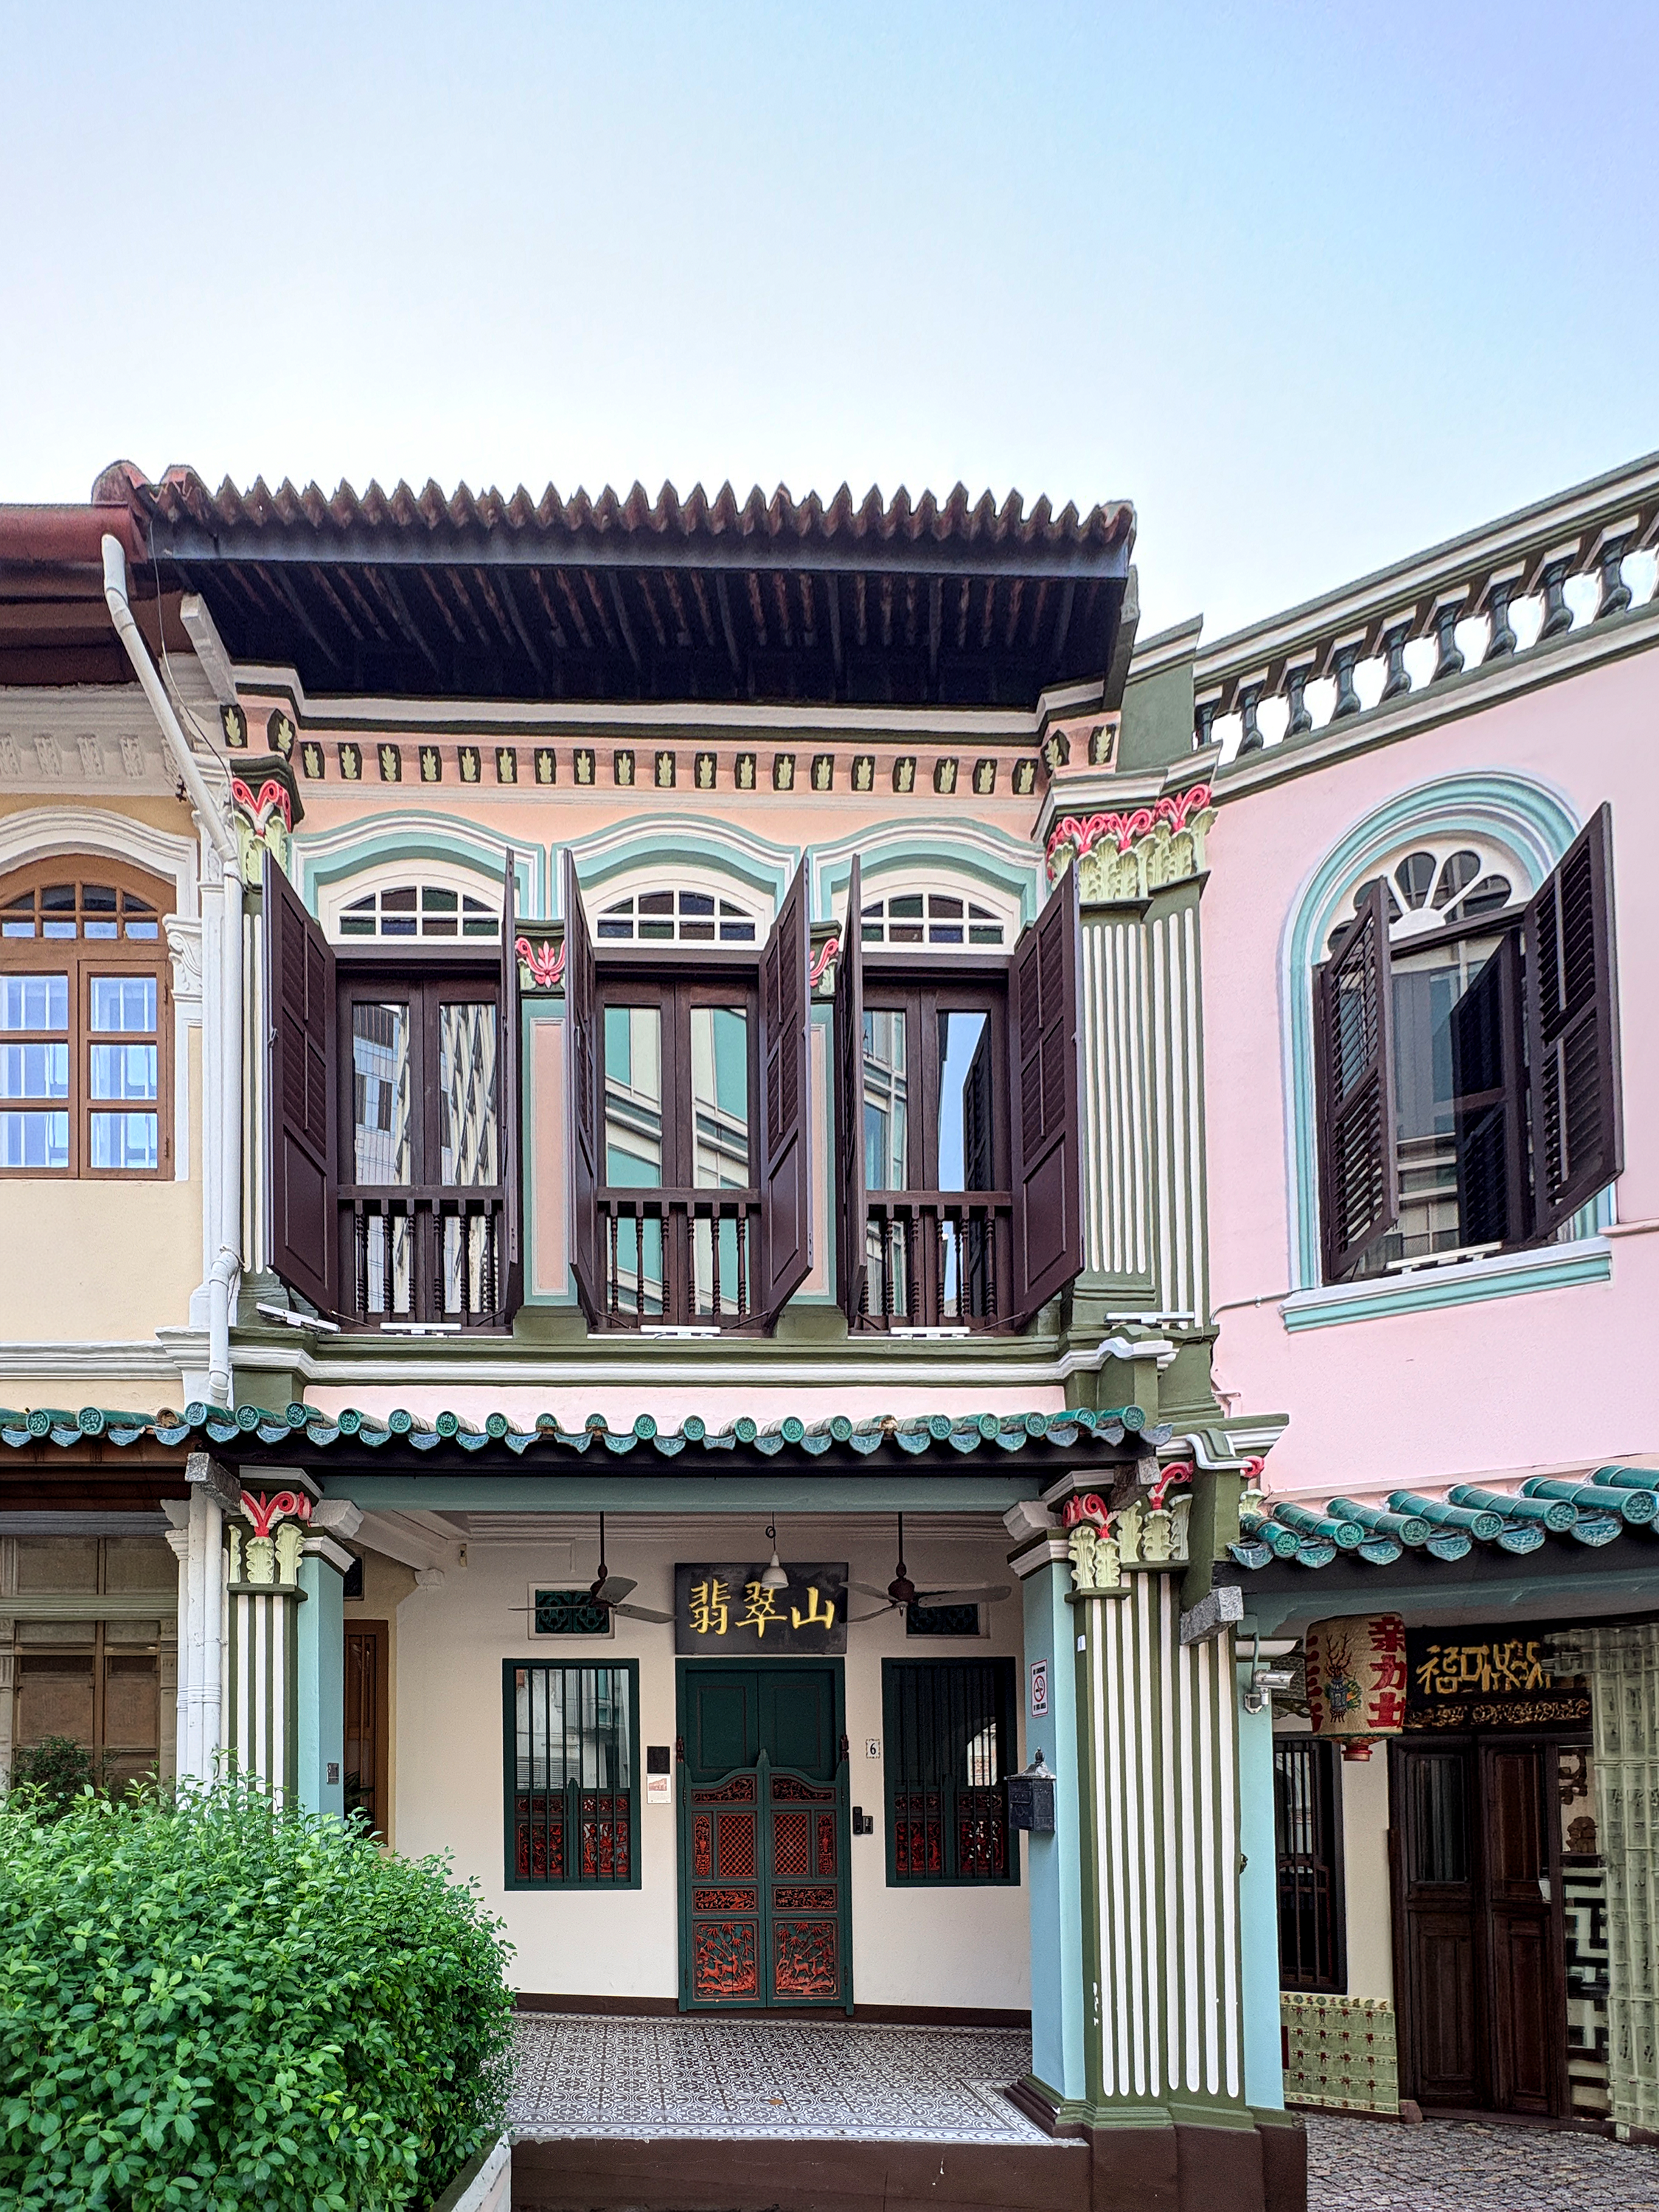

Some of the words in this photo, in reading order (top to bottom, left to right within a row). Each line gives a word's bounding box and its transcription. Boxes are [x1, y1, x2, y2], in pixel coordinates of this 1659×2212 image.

[689, 1579, 835, 1638] 翡翠山
[869, 1742, 877, 1755] 6
